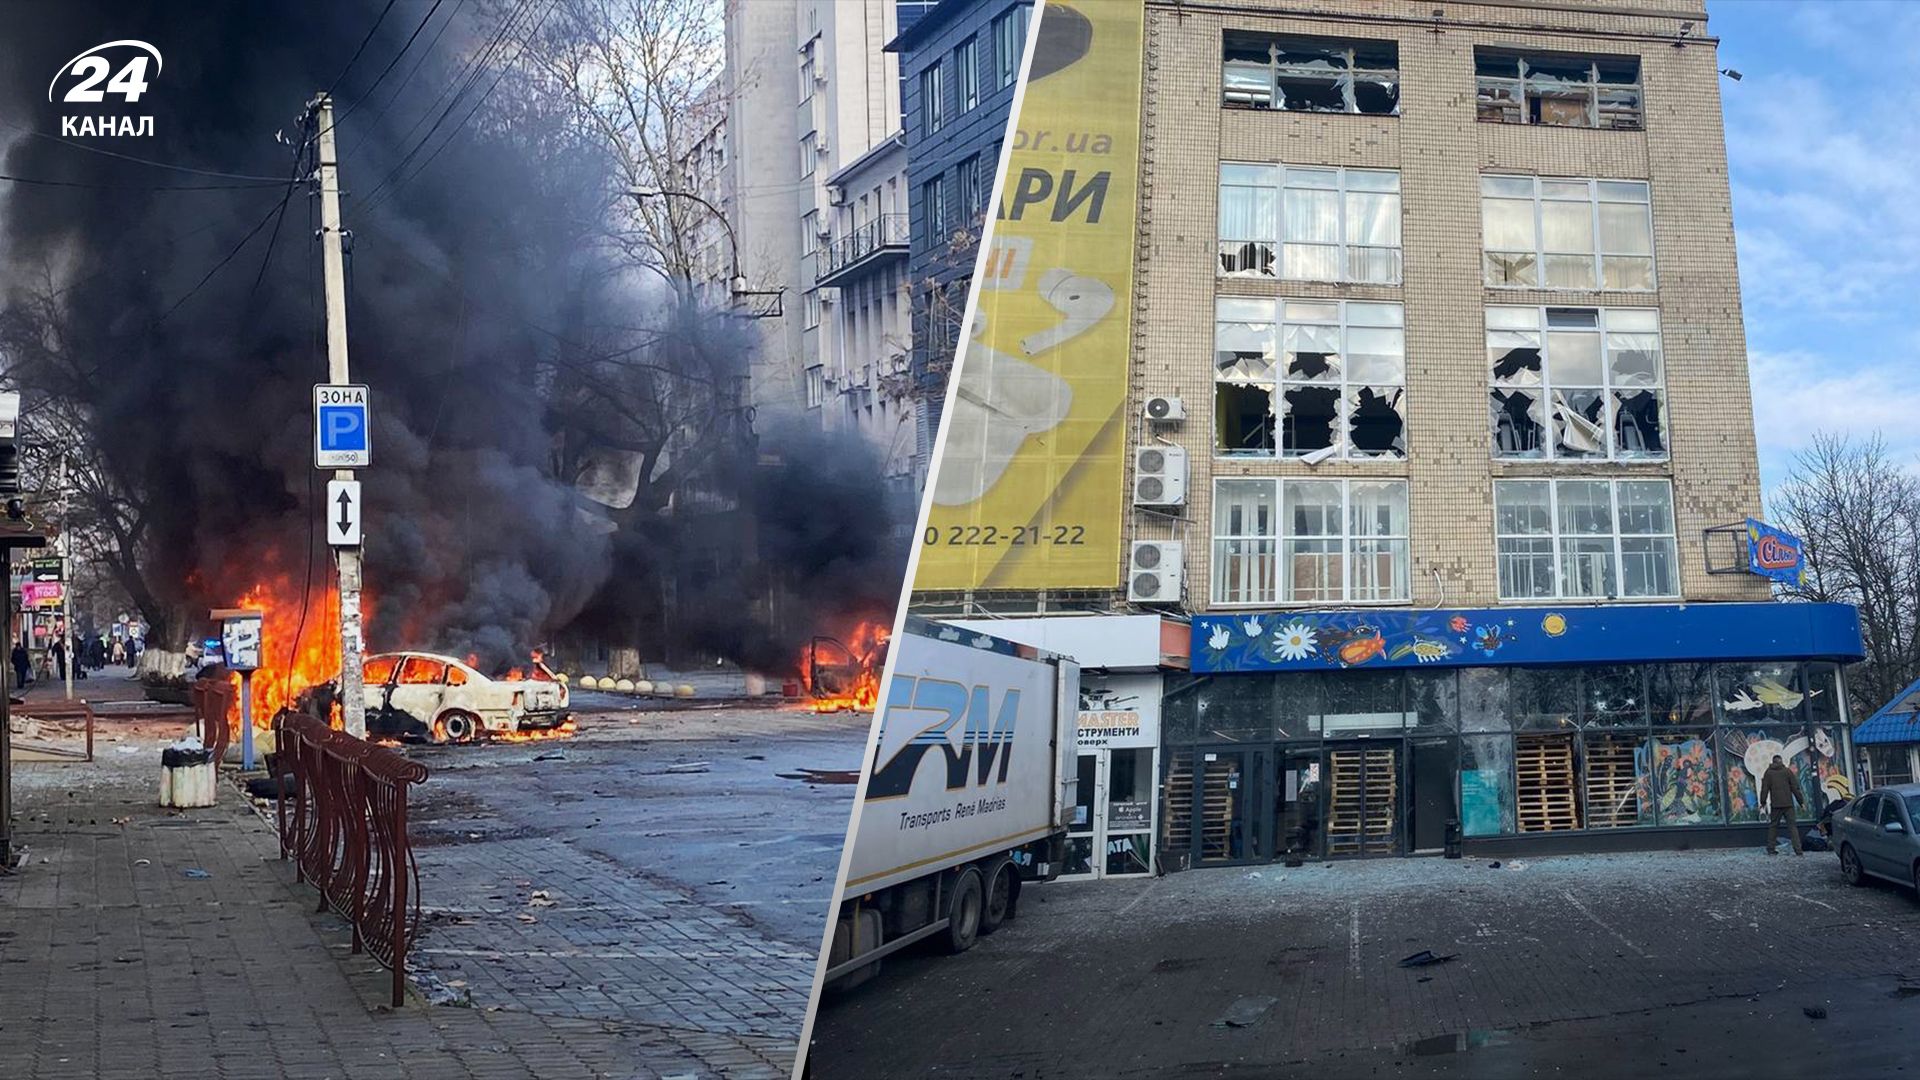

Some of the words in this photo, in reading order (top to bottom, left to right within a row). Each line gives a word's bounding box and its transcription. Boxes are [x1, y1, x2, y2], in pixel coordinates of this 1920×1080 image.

[320, 390, 364, 404] ЗОНА
[327, 411, 360, 447] P
[948, 525, 1085, 546] 222-21-22
[1077, 727, 1139, 737] СТРУМЕНТИ
[900, 808, 951, 830] Transports
[954, 801, 976, 819] René
